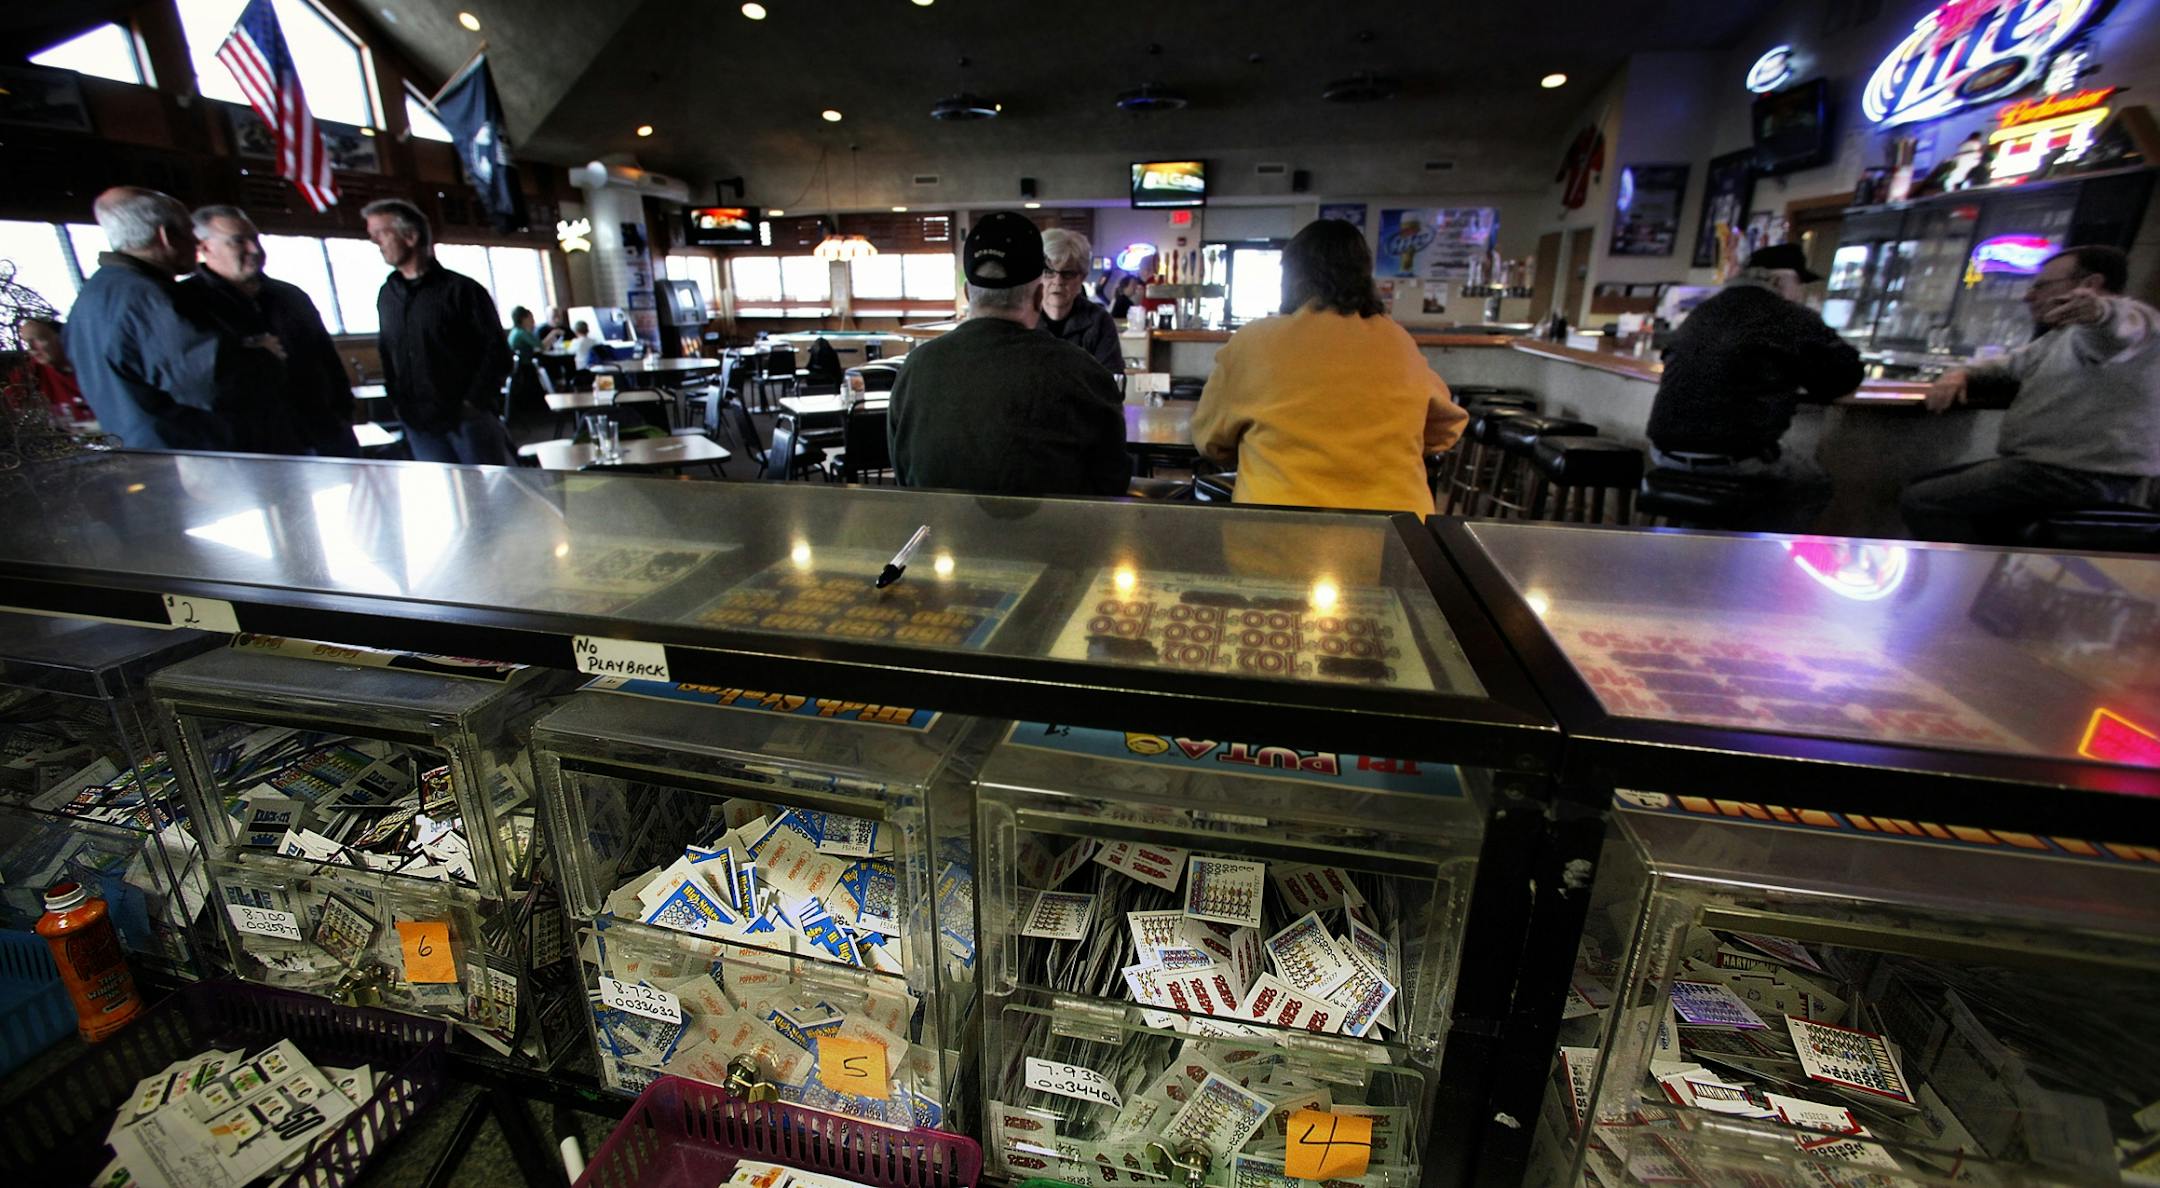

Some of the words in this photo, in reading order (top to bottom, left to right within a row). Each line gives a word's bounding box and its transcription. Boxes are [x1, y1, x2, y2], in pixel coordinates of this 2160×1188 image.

[167, 596, 200, 624] $2
[587, 656, 666, 678] PLAYBACK
[1219, 742, 1341, 776] PUT
[683, 885, 700, 902] High
[418, 935, 433, 957] 6
[612, 980, 668, 1003] 8.720
[843, 1055, 868, 1078] 5
[1037, 1062, 1102, 1084] 7.935
[1300, 1116, 1372, 1173] 4
